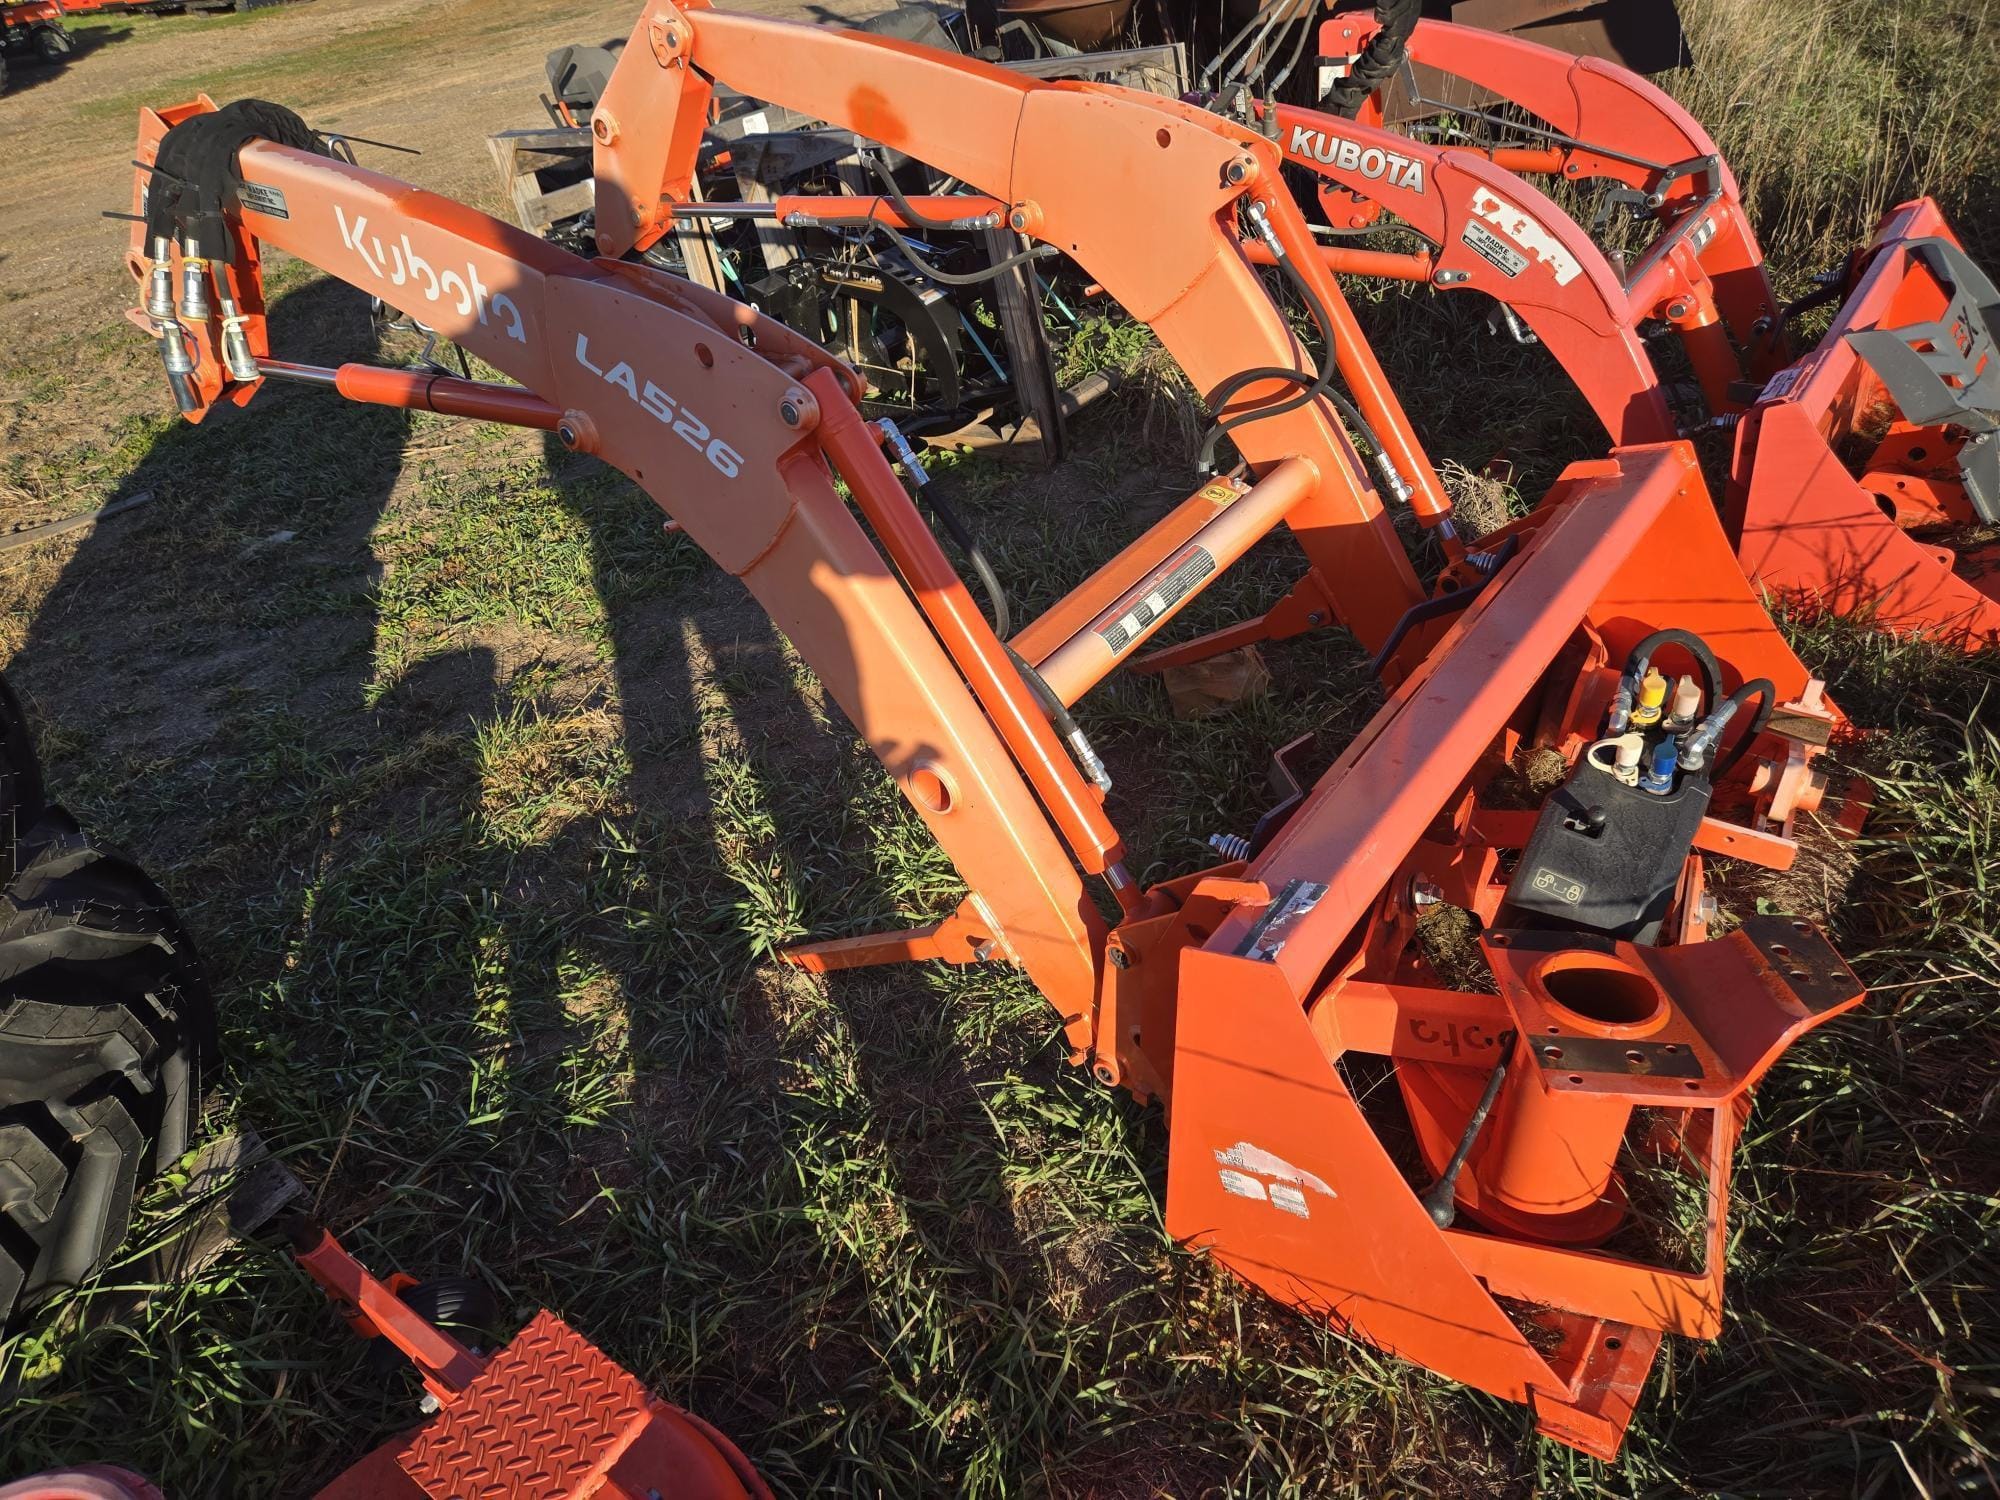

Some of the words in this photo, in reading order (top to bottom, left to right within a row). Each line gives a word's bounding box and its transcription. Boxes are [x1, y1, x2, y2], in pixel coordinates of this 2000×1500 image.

[1289, 125, 1425, 194] KUBOTA
[1476, 236, 1502, 257] IMPLEMENT
[1485, 235, 1510, 256] RADKE
[334, 204, 527, 344] Kubota
[852, 271, 882, 286] Pride
[574, 332, 745, 479] LA526
